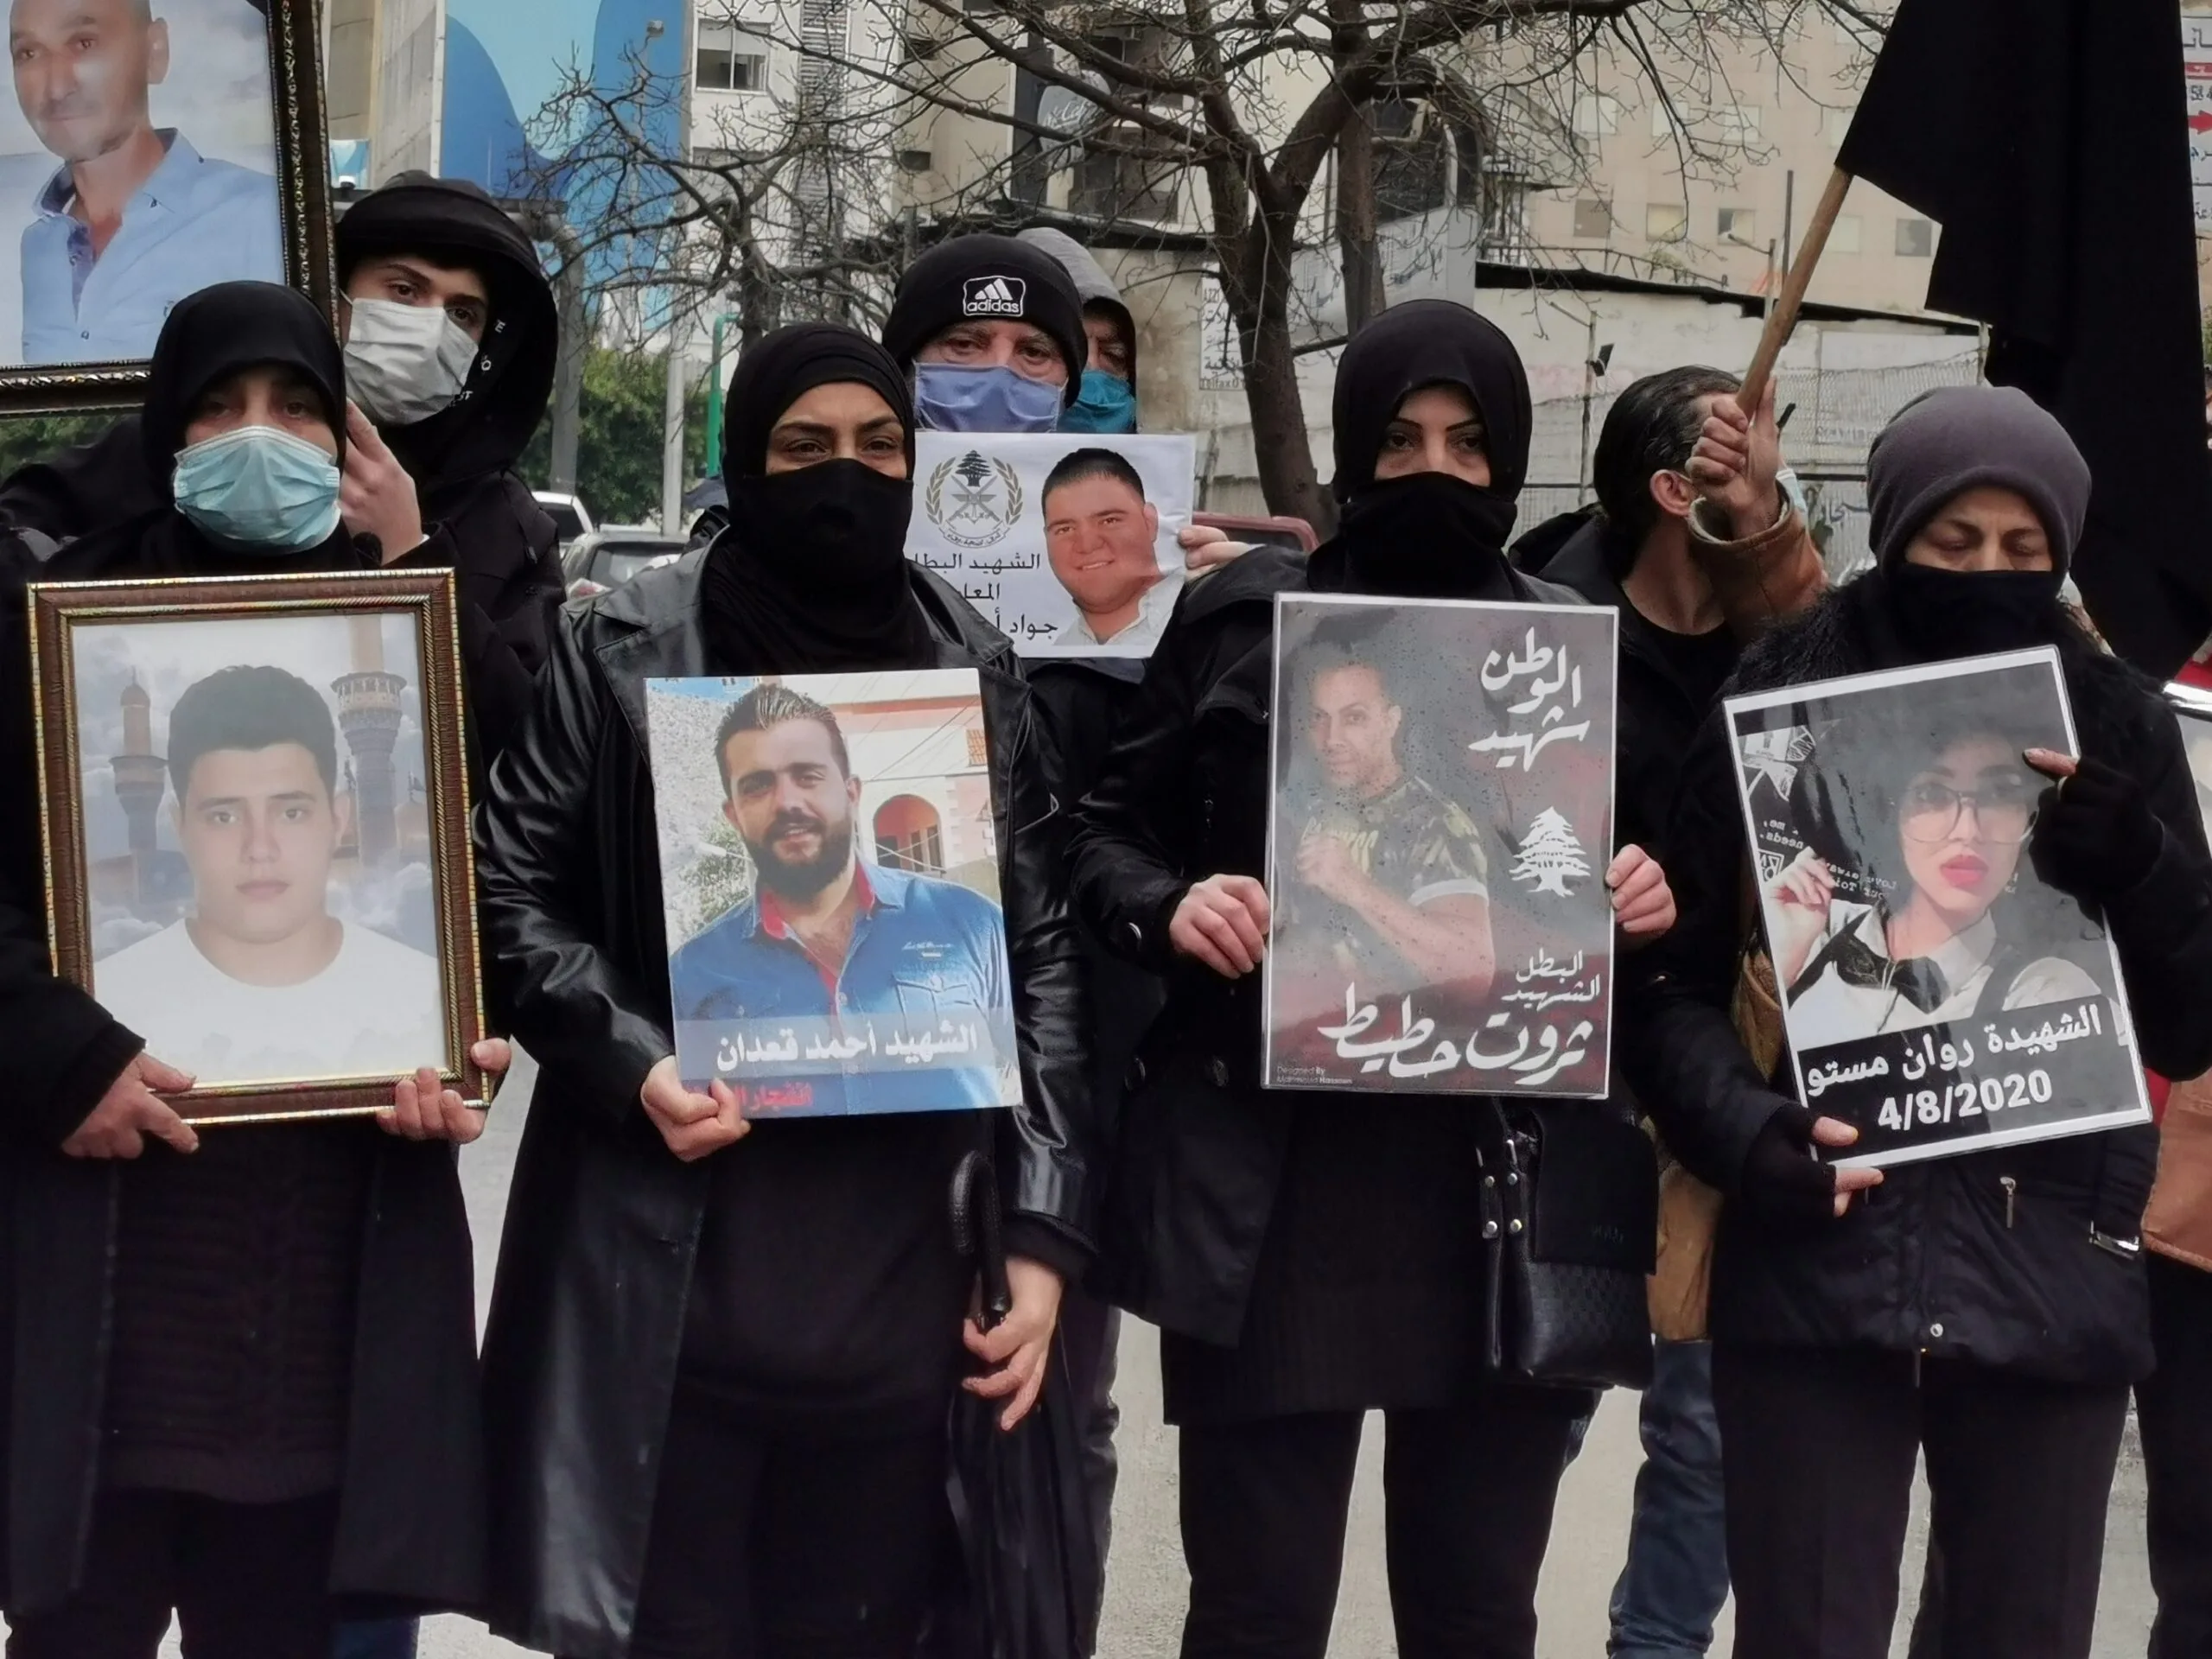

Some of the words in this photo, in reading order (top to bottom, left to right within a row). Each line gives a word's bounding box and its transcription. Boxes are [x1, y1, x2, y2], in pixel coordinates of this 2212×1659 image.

[967, 299, 1020, 313] adidas
[969, 552, 1040, 575] الشهيد
[963, 582, 1001, 601] المعا
[1009, 613, 1058, 641] جواد
[1480, 626, 1581, 715] الوطن
[1468, 705, 1591, 772] شهيد
[1516, 947, 1583, 984] البطل
[1501, 974, 1600, 1012] الشهيد
[717, 1028, 798, 1071] قعدان
[886, 1020, 978, 1064] الشهيد
[1465, 1013, 1594, 1086] ثروت
[1987, 1003, 2102, 1056] الشهيدة
[1807, 1054, 1890, 1096] مستو
[1902, 1033, 1975, 1082] روان
[1877, 1069, 2053, 1131] 4/8/2020
